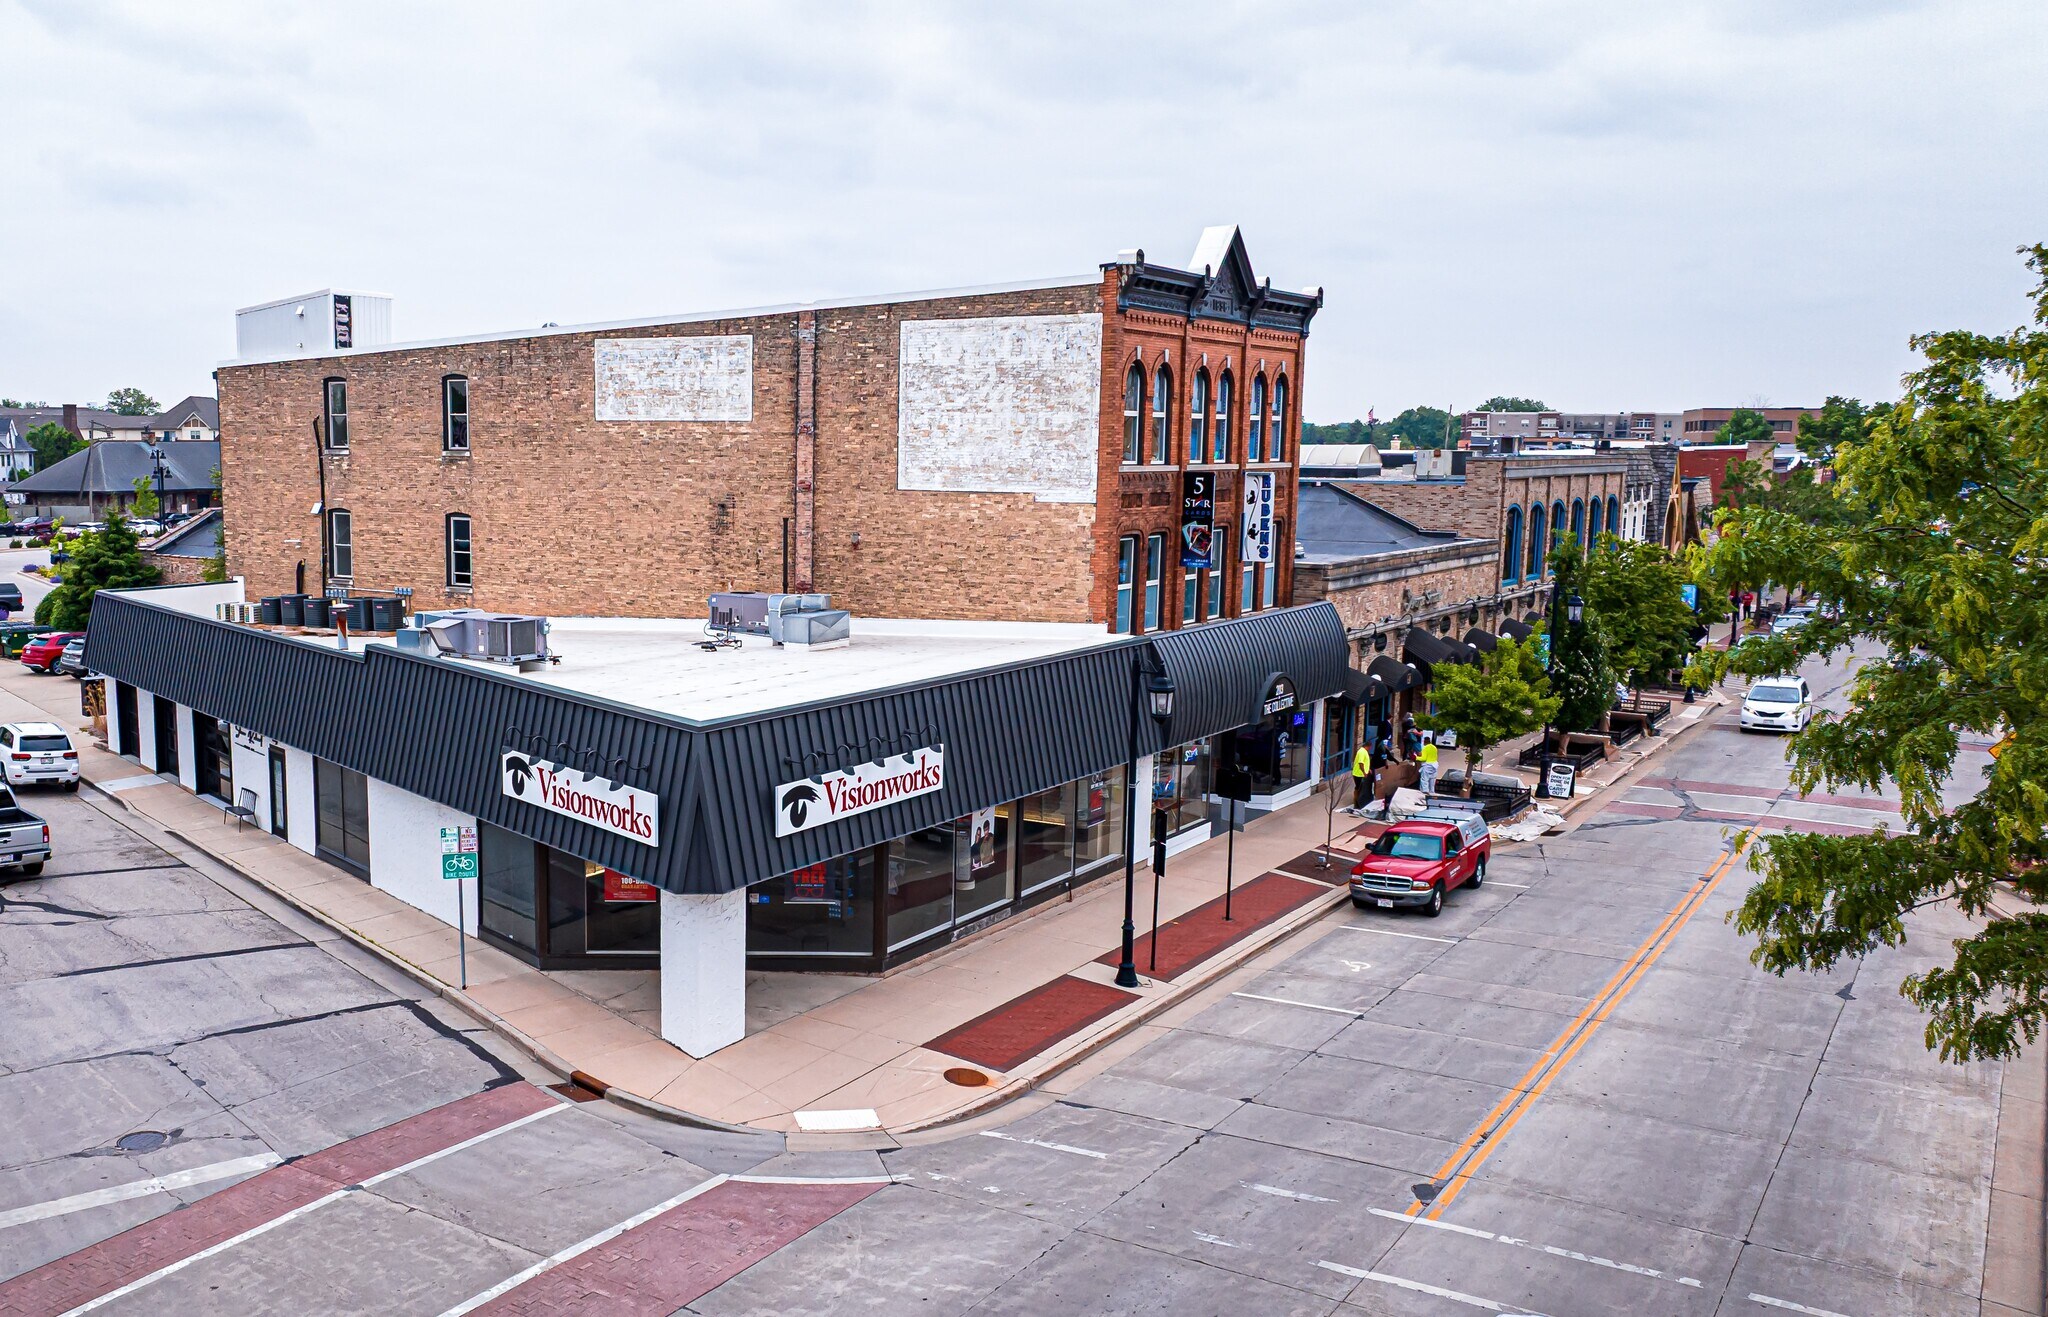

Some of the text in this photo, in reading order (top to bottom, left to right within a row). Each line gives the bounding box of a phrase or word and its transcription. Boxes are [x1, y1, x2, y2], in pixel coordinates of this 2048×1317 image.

[1193, 477, 1204, 495] 5
[1257, 475, 1272, 559] RUBEN'S
[1263, 696, 1294, 715] THE COLLECTIVE
[536, 766, 652, 839] Visionworks
[823, 754, 940, 815] Visionworks
[793, 870, 827, 884] FREE
